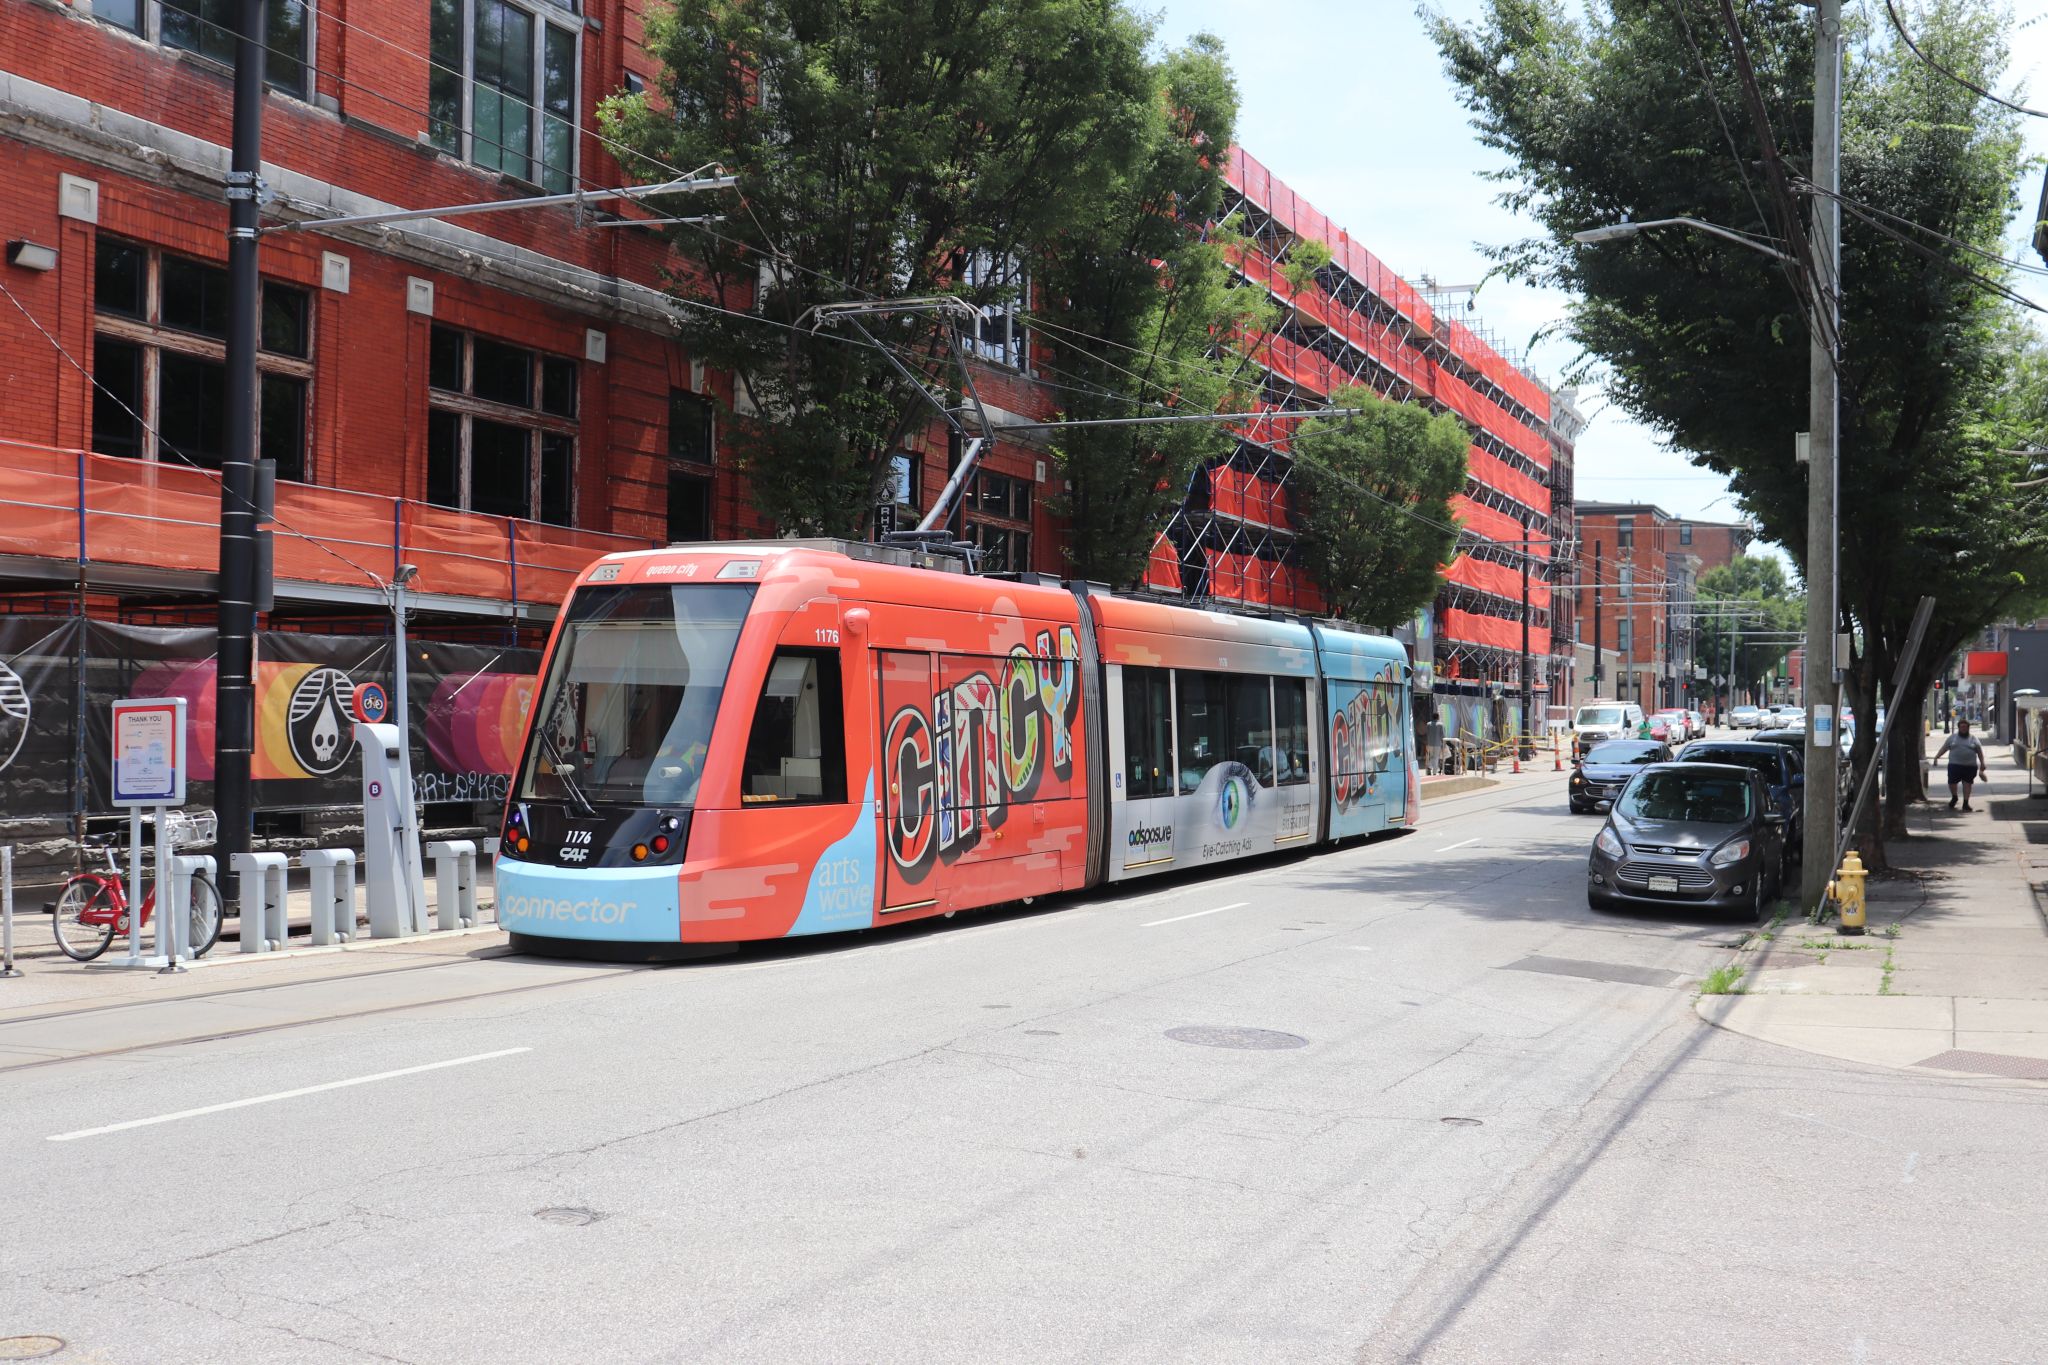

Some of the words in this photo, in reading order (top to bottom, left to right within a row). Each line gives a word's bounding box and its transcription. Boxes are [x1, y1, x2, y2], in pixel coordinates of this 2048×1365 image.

[646, 564, 675, 578] queen
[676, 562, 699, 577] city
[815, 628, 840, 644] 1176
[128, 716, 147, 724] THANK
[372, 784, 379, 794] B
[565, 830, 593, 845] 1176
[1128, 820, 1172, 852] adsposure
[559, 847, 590, 862] CAF
[1202, 840, 1240, 860] Eye-Catching
[1242, 838, 1252, 851] Ads
[818, 857, 860, 887] arts
[818, 885, 871, 912] wave
[505, 895, 637, 924] connector
